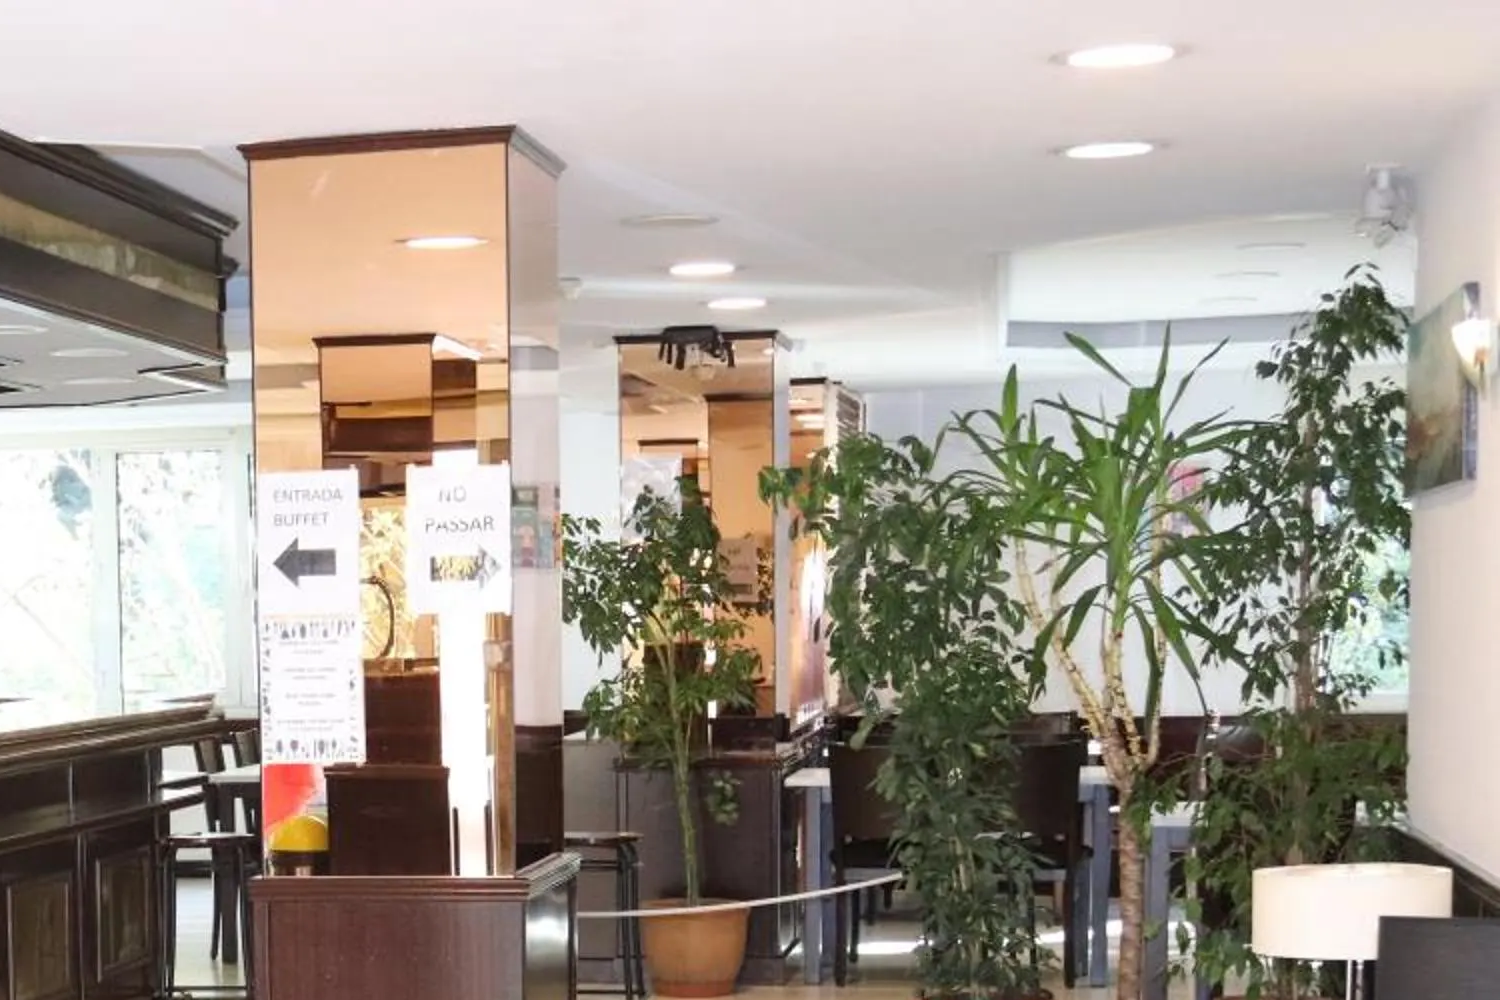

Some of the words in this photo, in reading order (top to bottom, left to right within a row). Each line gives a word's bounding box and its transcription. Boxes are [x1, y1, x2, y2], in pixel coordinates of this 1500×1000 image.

[273, 488, 343, 503] ENTRADA
[439, 486, 467, 502] NO
[273, 511, 330, 527] BUFFET
[425, 515, 495, 534] PASSAR
